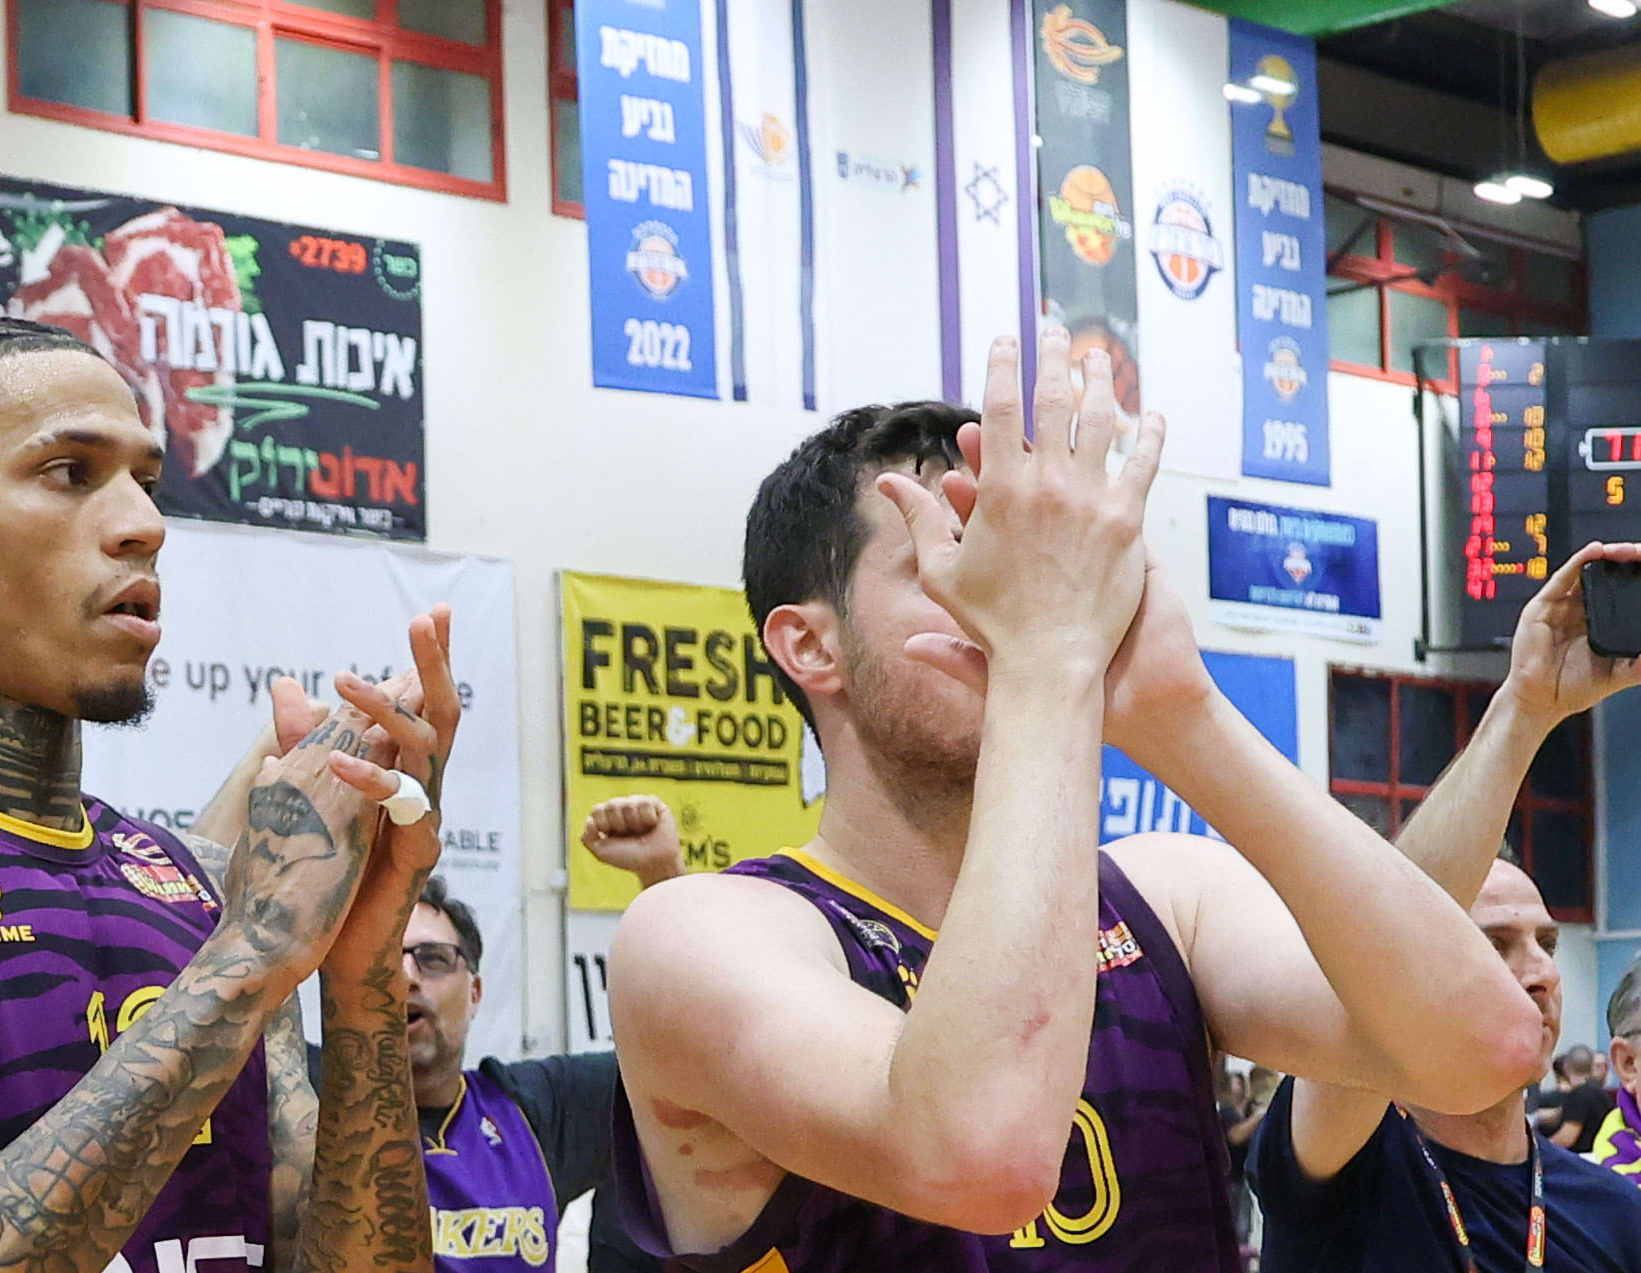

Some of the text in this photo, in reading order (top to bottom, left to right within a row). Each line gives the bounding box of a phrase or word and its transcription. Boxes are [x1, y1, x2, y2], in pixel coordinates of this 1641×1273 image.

[620, 95, 676, 144] גביע
[609, 159, 694, 212] המדינה
[295, 319, 417, 401] איכות
[624, 318, 692, 373] 2022
[1263, 418, 1308, 464] 1995
[185, 659, 230, 704] up
[581, 618, 786, 706] FRESH
[1009, 1099, 1122, 1250] 0
[432, 1206, 550, 1267] KERS
